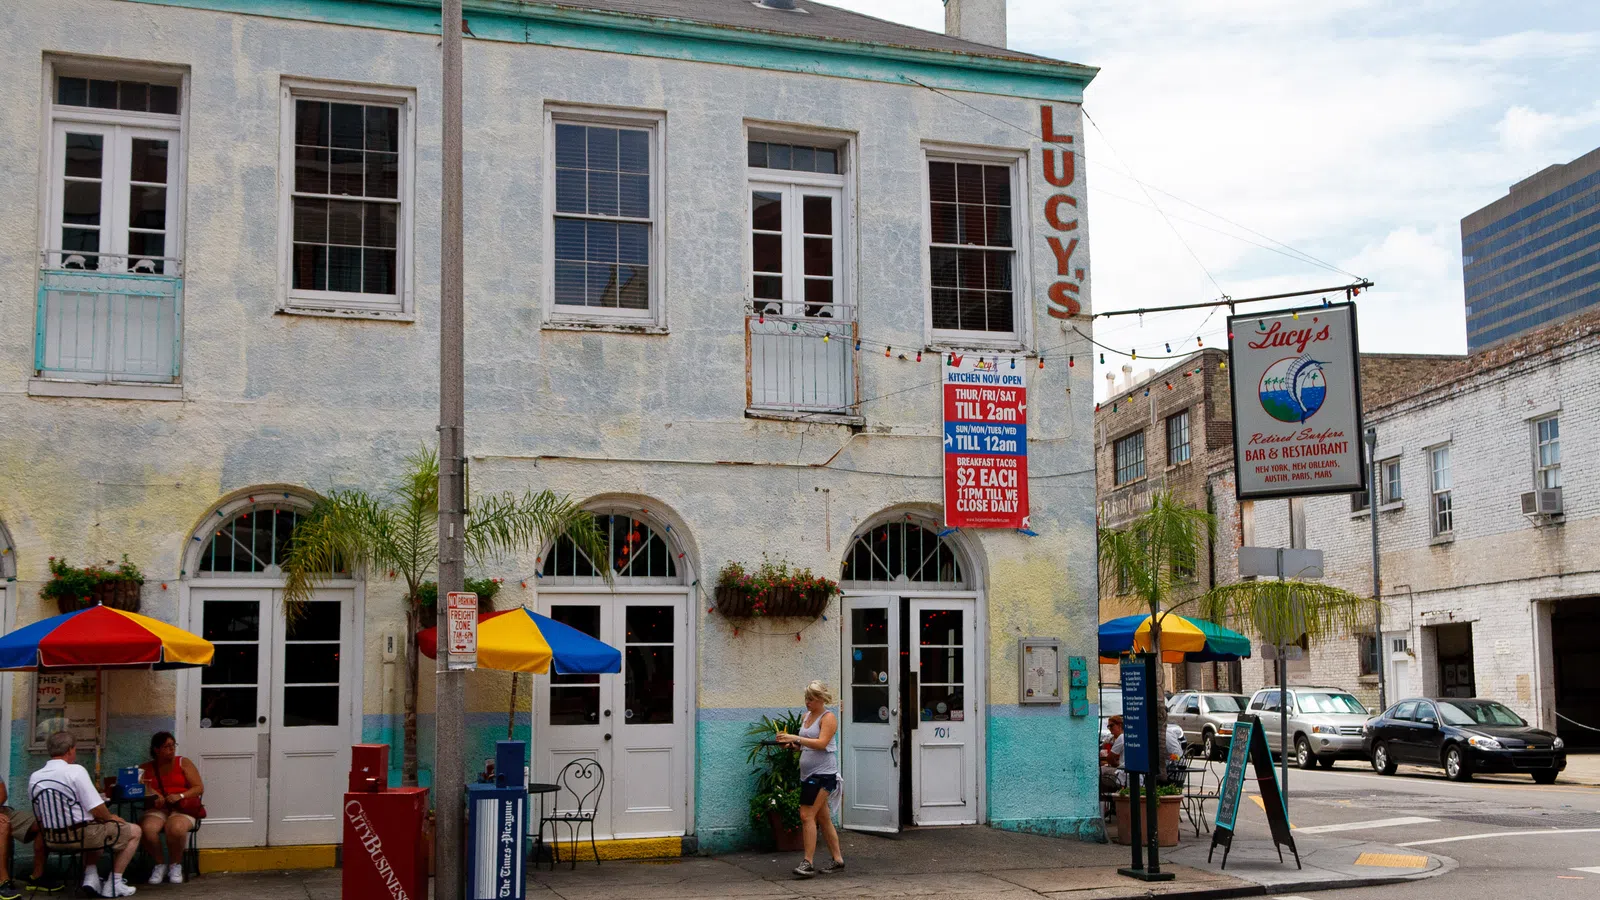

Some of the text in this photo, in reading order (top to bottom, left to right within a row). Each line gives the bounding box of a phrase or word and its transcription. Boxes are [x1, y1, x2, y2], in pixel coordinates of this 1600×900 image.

[1040, 105, 1085, 320] LUCY'S
[1248, 317, 1330, 353] Lucy's
[948, 372, 1022, 385] KITCHEN NOW OPEN
[955, 388, 1016, 402] THUR/FRI/SAT
[955, 402, 1016, 421] TILL 2am
[955, 424, 1017, 435] SUN/MON/TUES/WED
[955, 435, 1017, 452] TILL 12am
[1248, 431, 1296, 445] Retired
[1245, 441, 1349, 462] BAR & RESTAURANT
[956, 457, 1017, 468] BREAKFAST TACOS
[1255, 465, 1269, 474] NEW
[1292, 462, 1307, 471] NEW
[956, 466, 1018, 488] $2 EACH
[1314, 470, 1333, 479] MARS
[957, 488, 1018, 501] 11PM TILL WE
[956, 499, 1019, 513] CLOSE DAILY
[449, 595, 476, 607] NO PARKING
[451, 611, 474, 620] FREIGHT
[455, 621, 471, 630] ZONE
[934, 726, 950, 739] 701
[345, 800, 410, 900] CITYBUSINES
[499, 879, 511, 898] The
